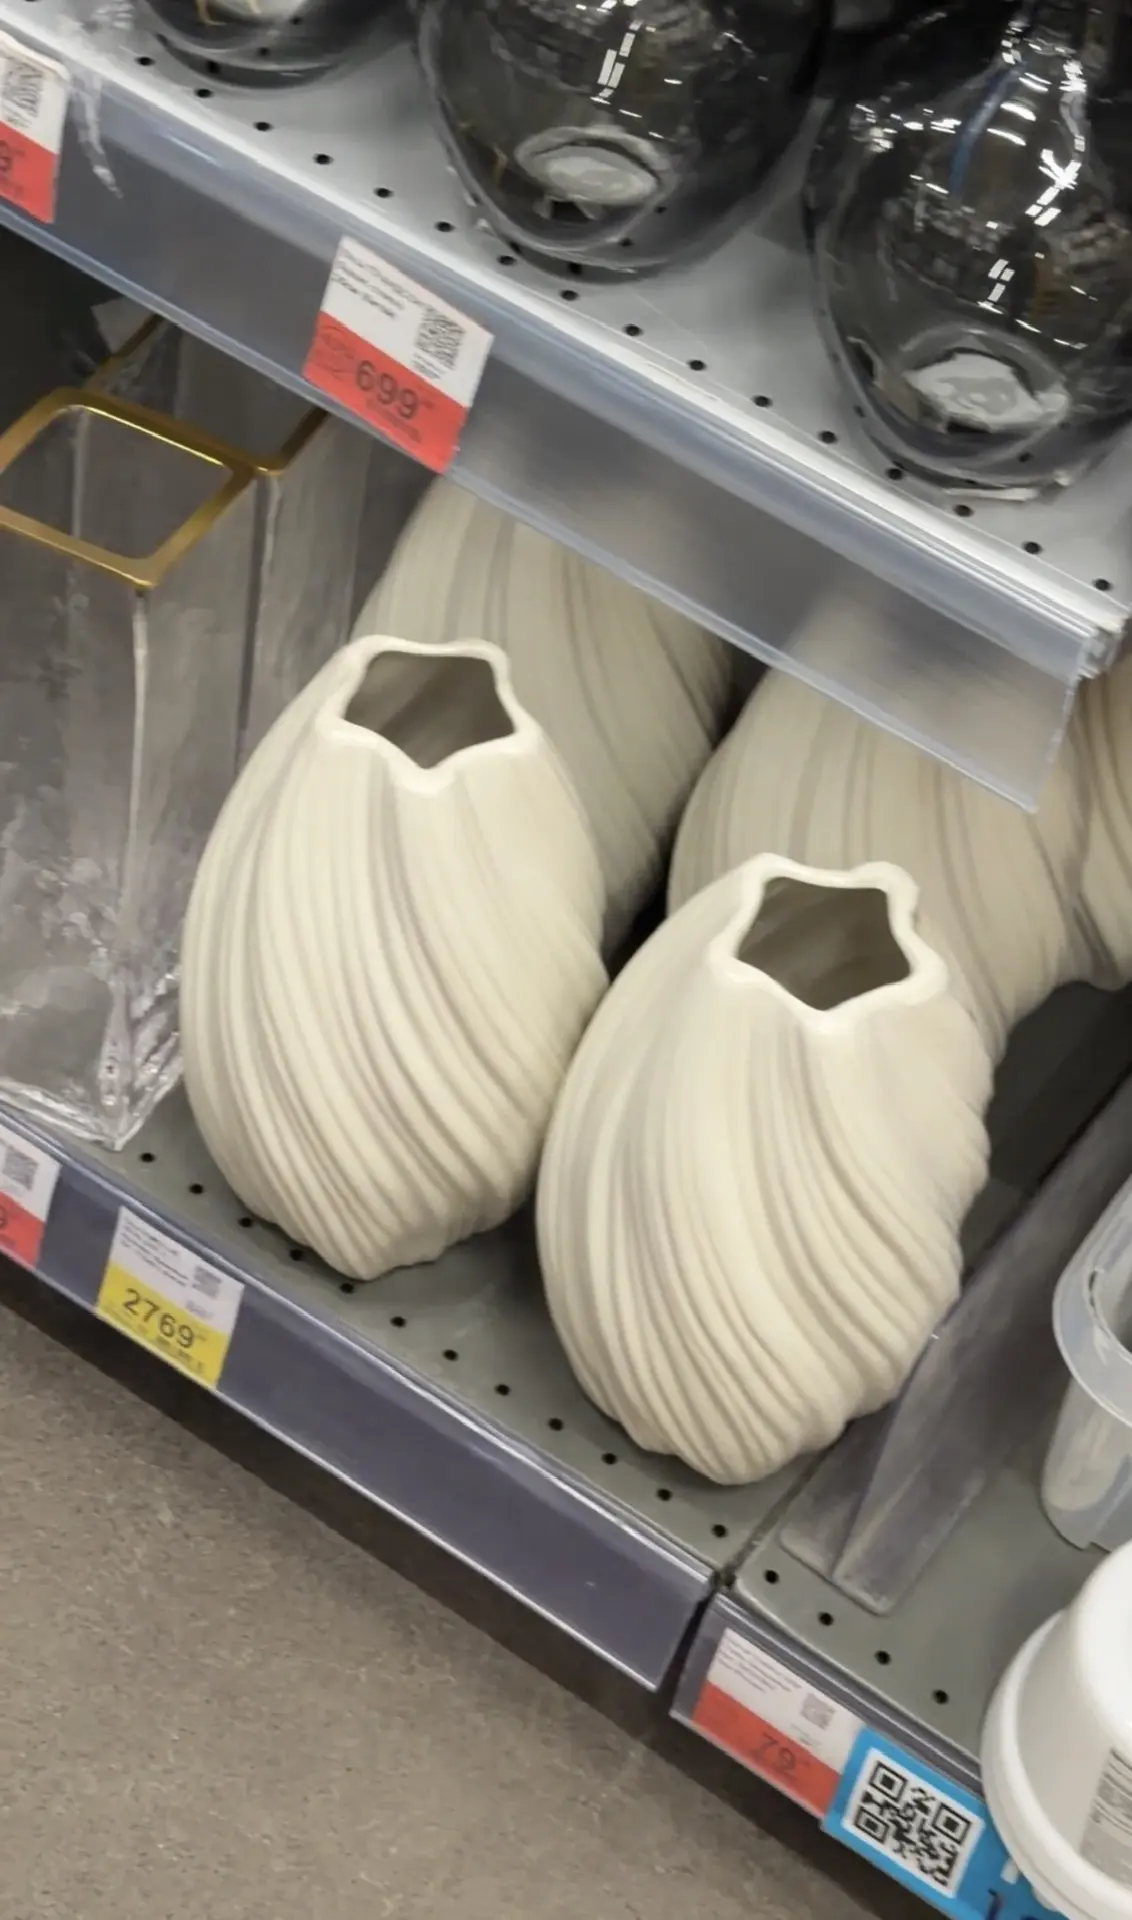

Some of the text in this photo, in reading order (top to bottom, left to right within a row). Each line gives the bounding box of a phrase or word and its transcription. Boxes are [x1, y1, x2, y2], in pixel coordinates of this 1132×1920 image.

[356, 359, 419, 420] 699
[123, 1287, 195, 1349] 2769
[756, 1731, 797, 1772] 79
